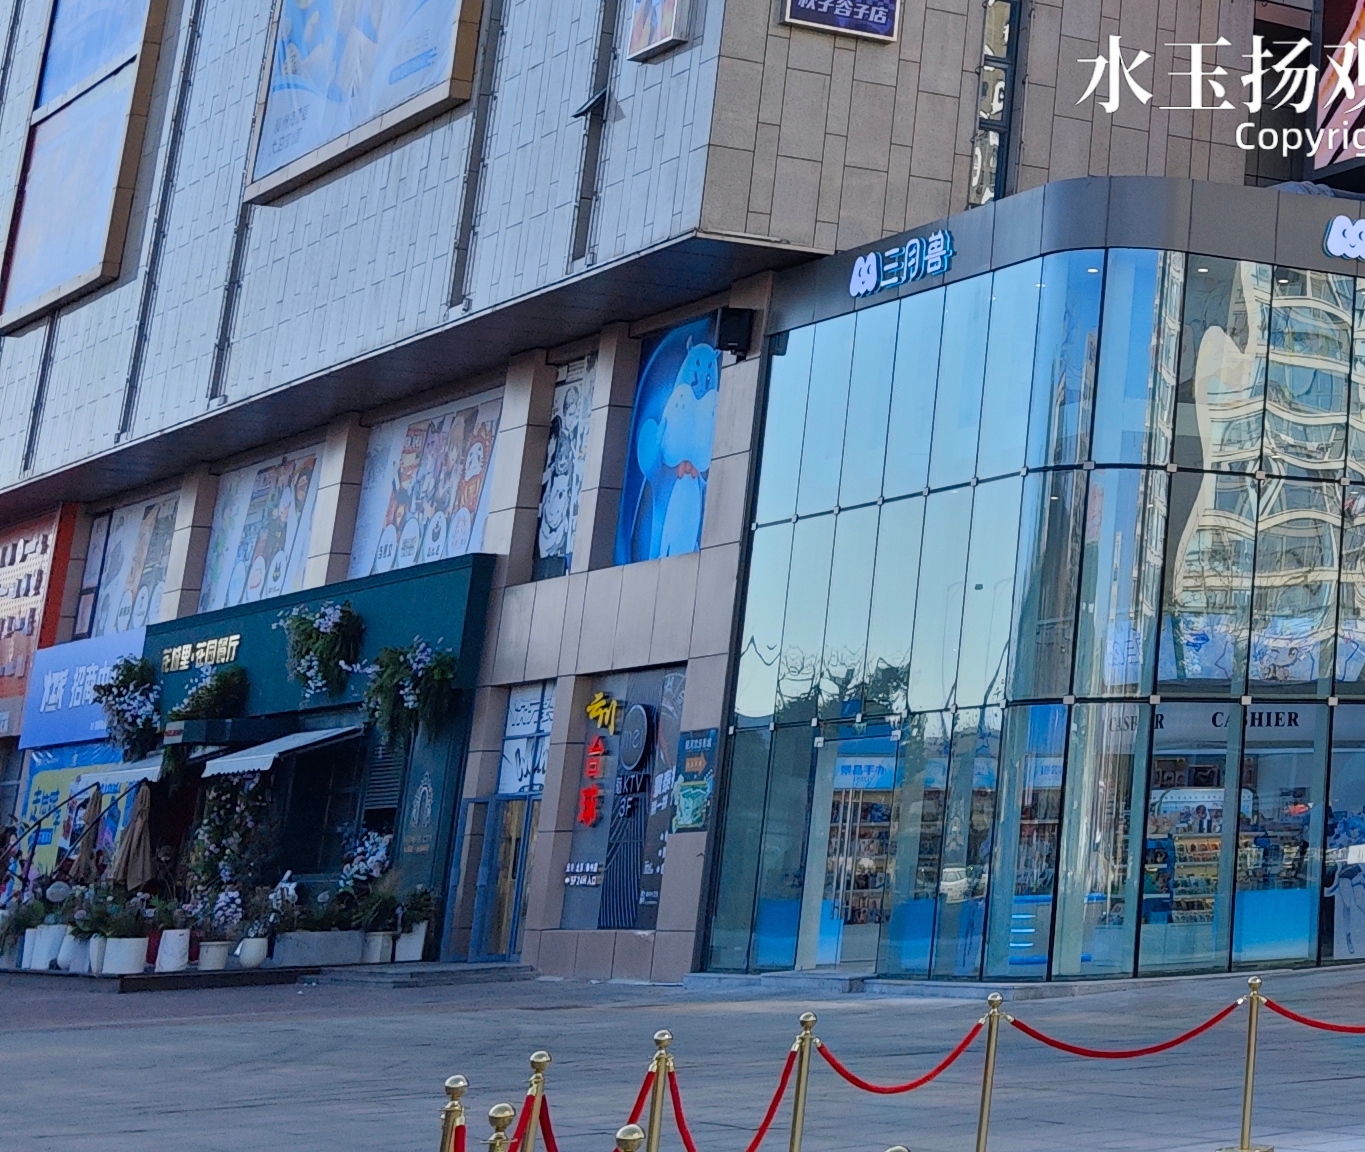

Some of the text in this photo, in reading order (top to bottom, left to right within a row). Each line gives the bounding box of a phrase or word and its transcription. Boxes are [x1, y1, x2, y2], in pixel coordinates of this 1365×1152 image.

[879, 228, 957, 289] 三月兽
[68, 659, 115, 709] 招商中
[1211, 711, 1300, 729] CAHIER
[618, 797, 633, 818] 3F
